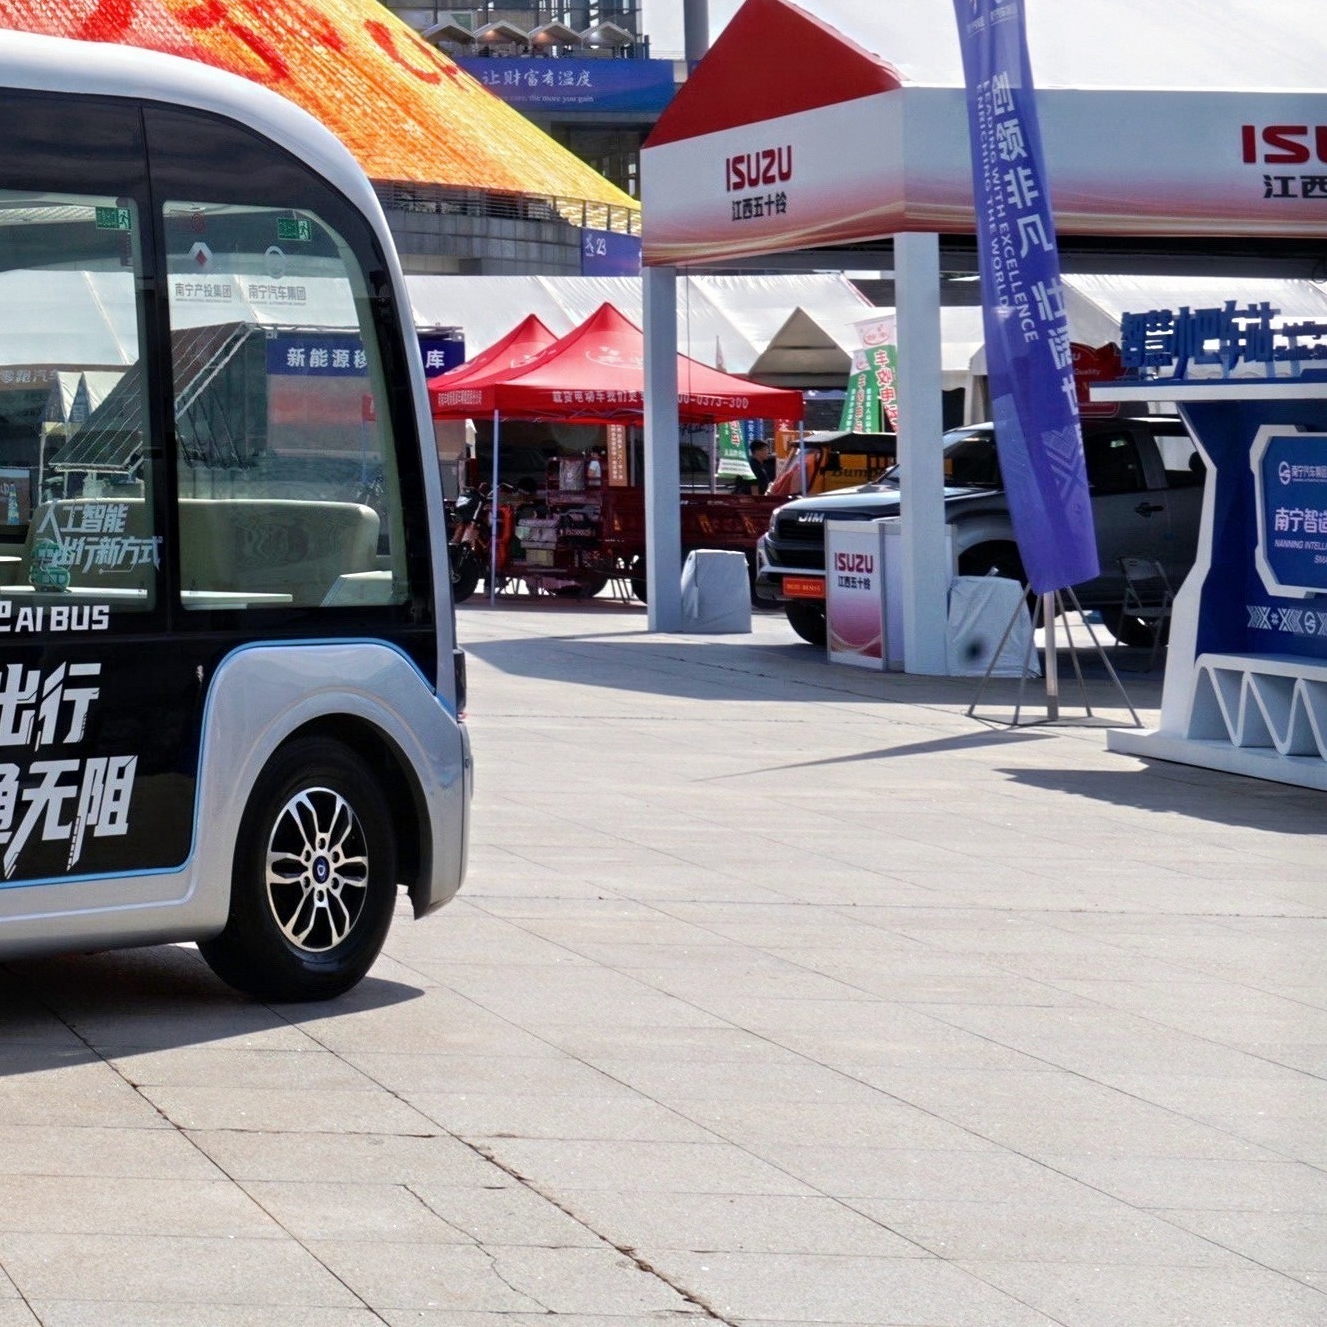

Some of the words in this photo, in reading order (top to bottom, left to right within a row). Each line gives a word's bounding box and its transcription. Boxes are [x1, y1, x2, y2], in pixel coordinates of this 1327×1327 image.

[482, 68, 593, 87] 让财富有温度
[1242, 125, 1327, 164] IS
[726, 145, 792, 192] ISUZU
[731, 191, 788, 222] 江西五十铃
[175, 283, 232, 298] 南宁产投集团
[248, 284, 307, 300] 南宁汽车集团
[1001, 222, 1040, 343] EXCELLENCE
[36, 499, 129, 535] 人工智能
[834, 553, 874, 573] ISUZU
[837, 575, 871, 590] 江西五十铃
[15, 607, 43, 633] AI
[50, 605, 109, 632] BUS
